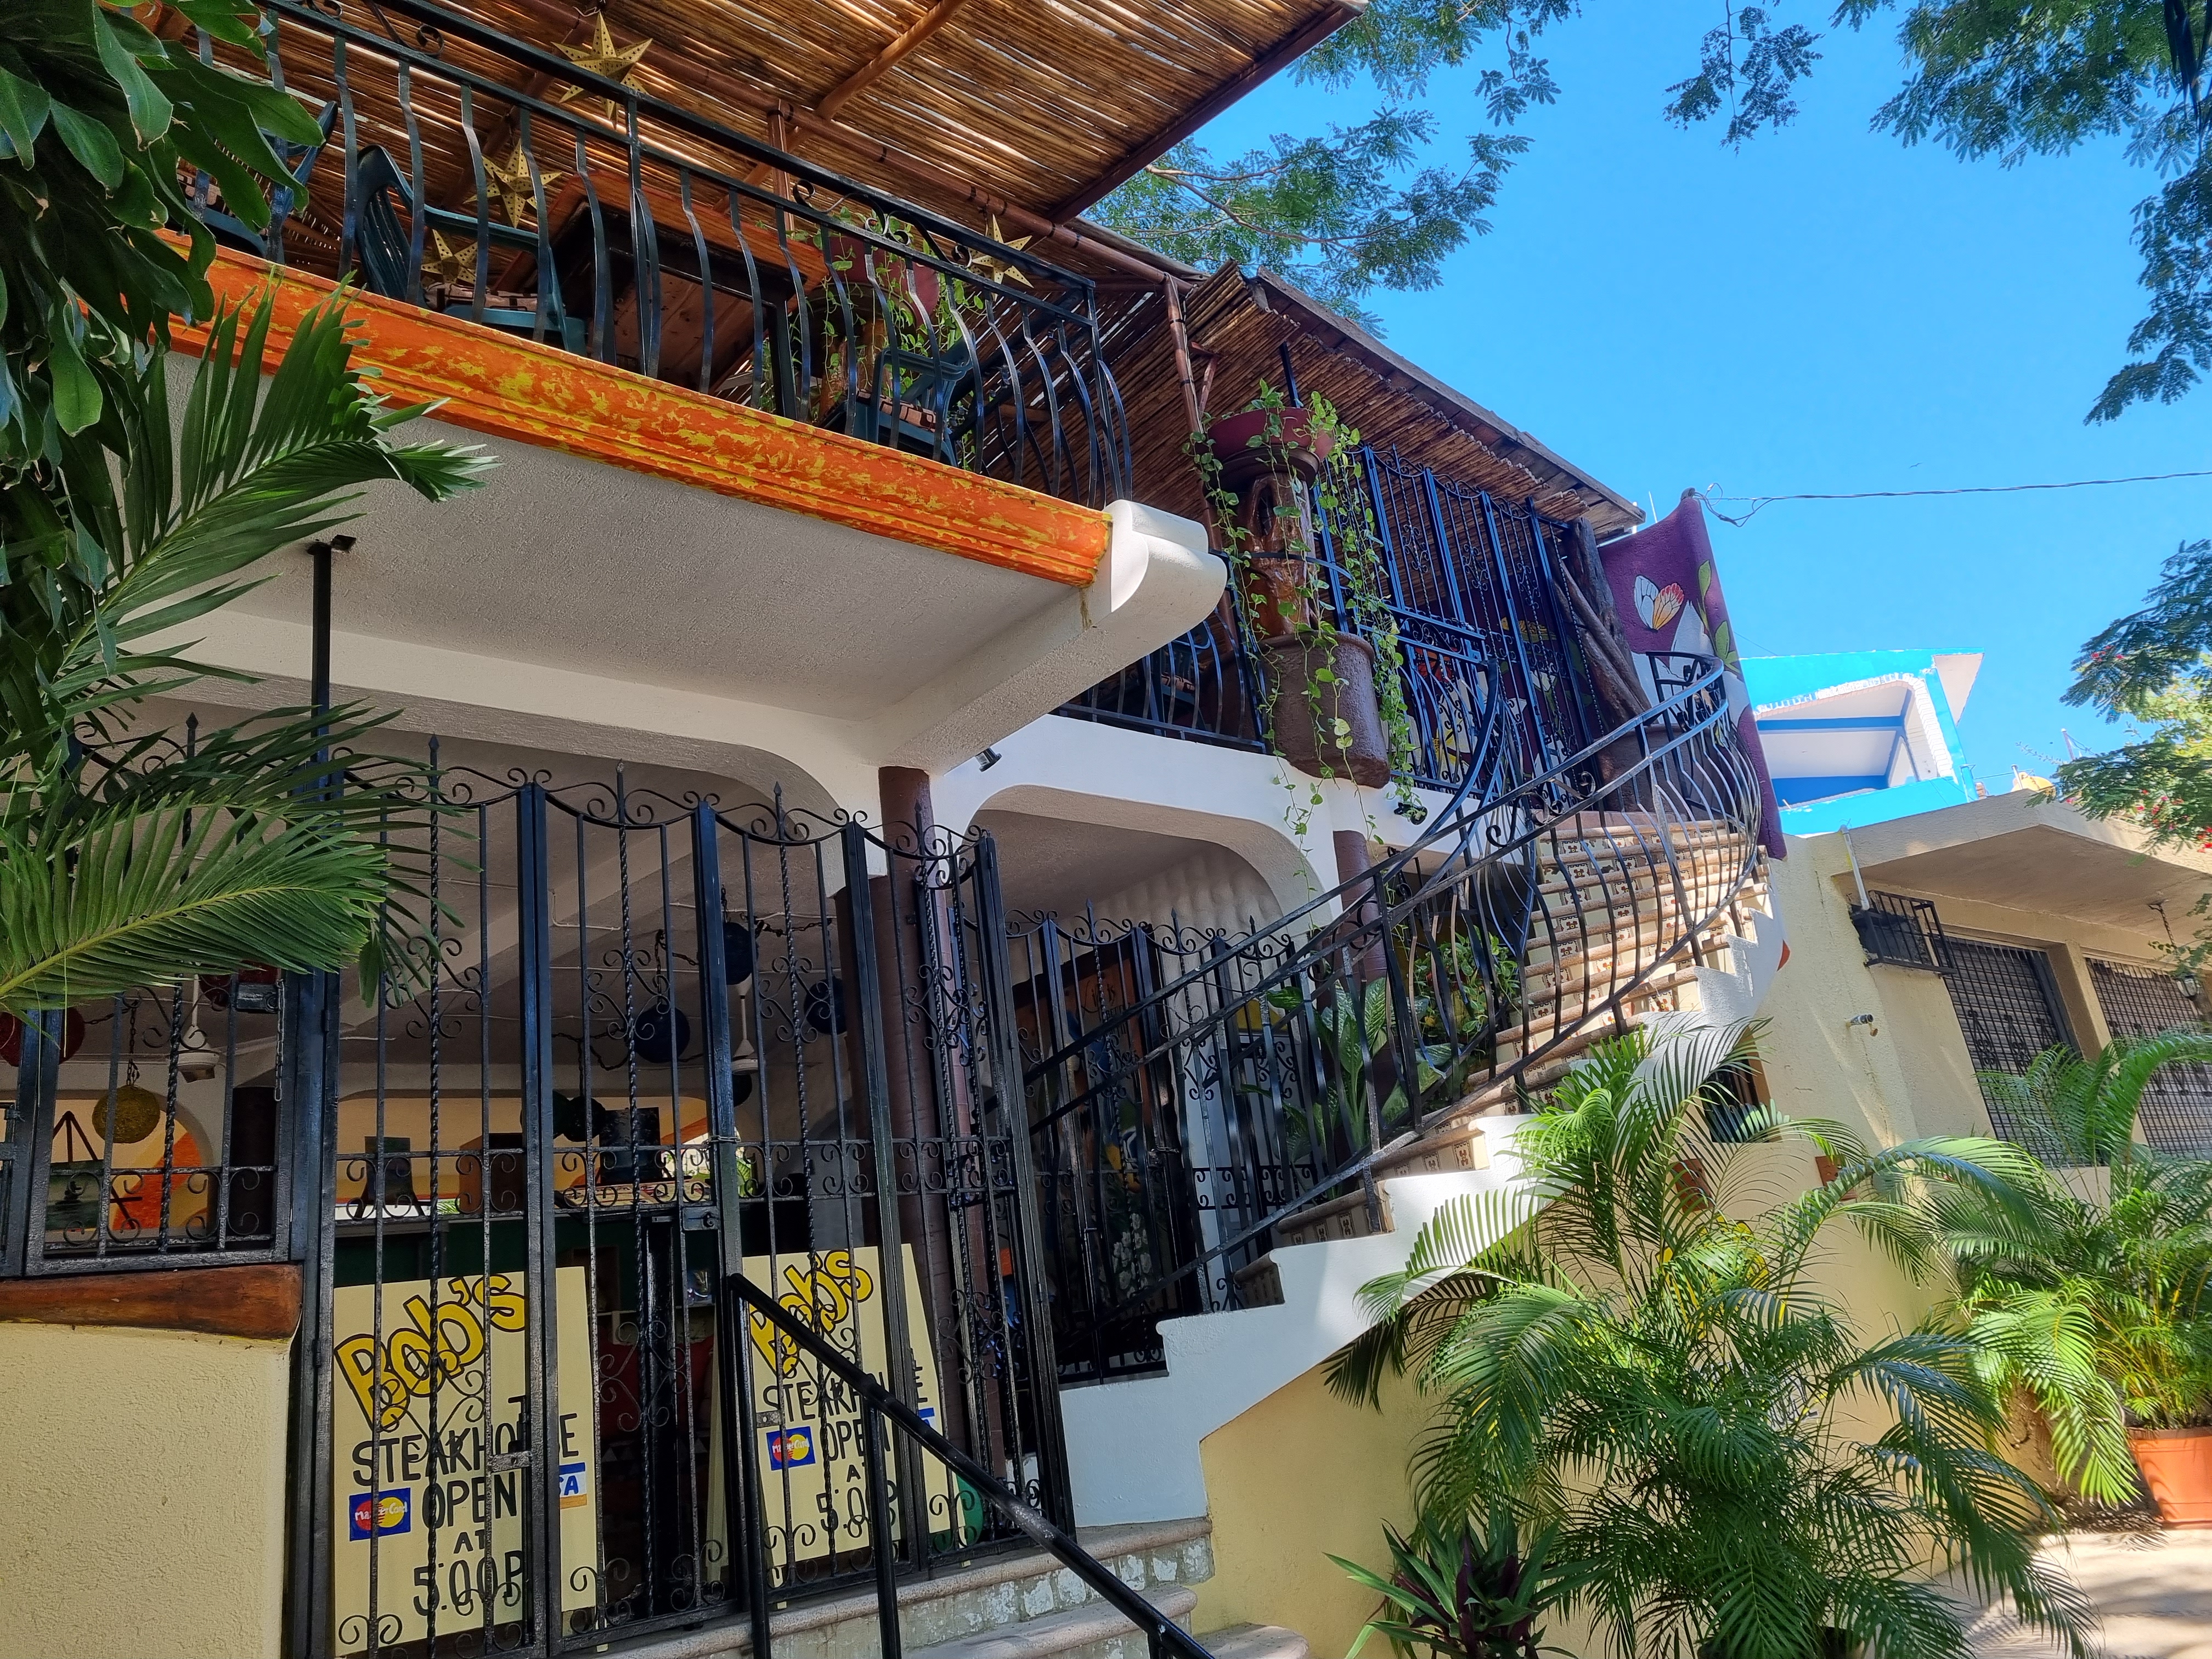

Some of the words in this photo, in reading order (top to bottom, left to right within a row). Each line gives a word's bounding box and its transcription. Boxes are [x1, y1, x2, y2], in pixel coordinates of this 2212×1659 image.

[352, 1412, 579, 1486] STEAKHOE
[354, 1501, 408, 1521] MaerCard
[422, 1471, 517, 1529] OPEN
